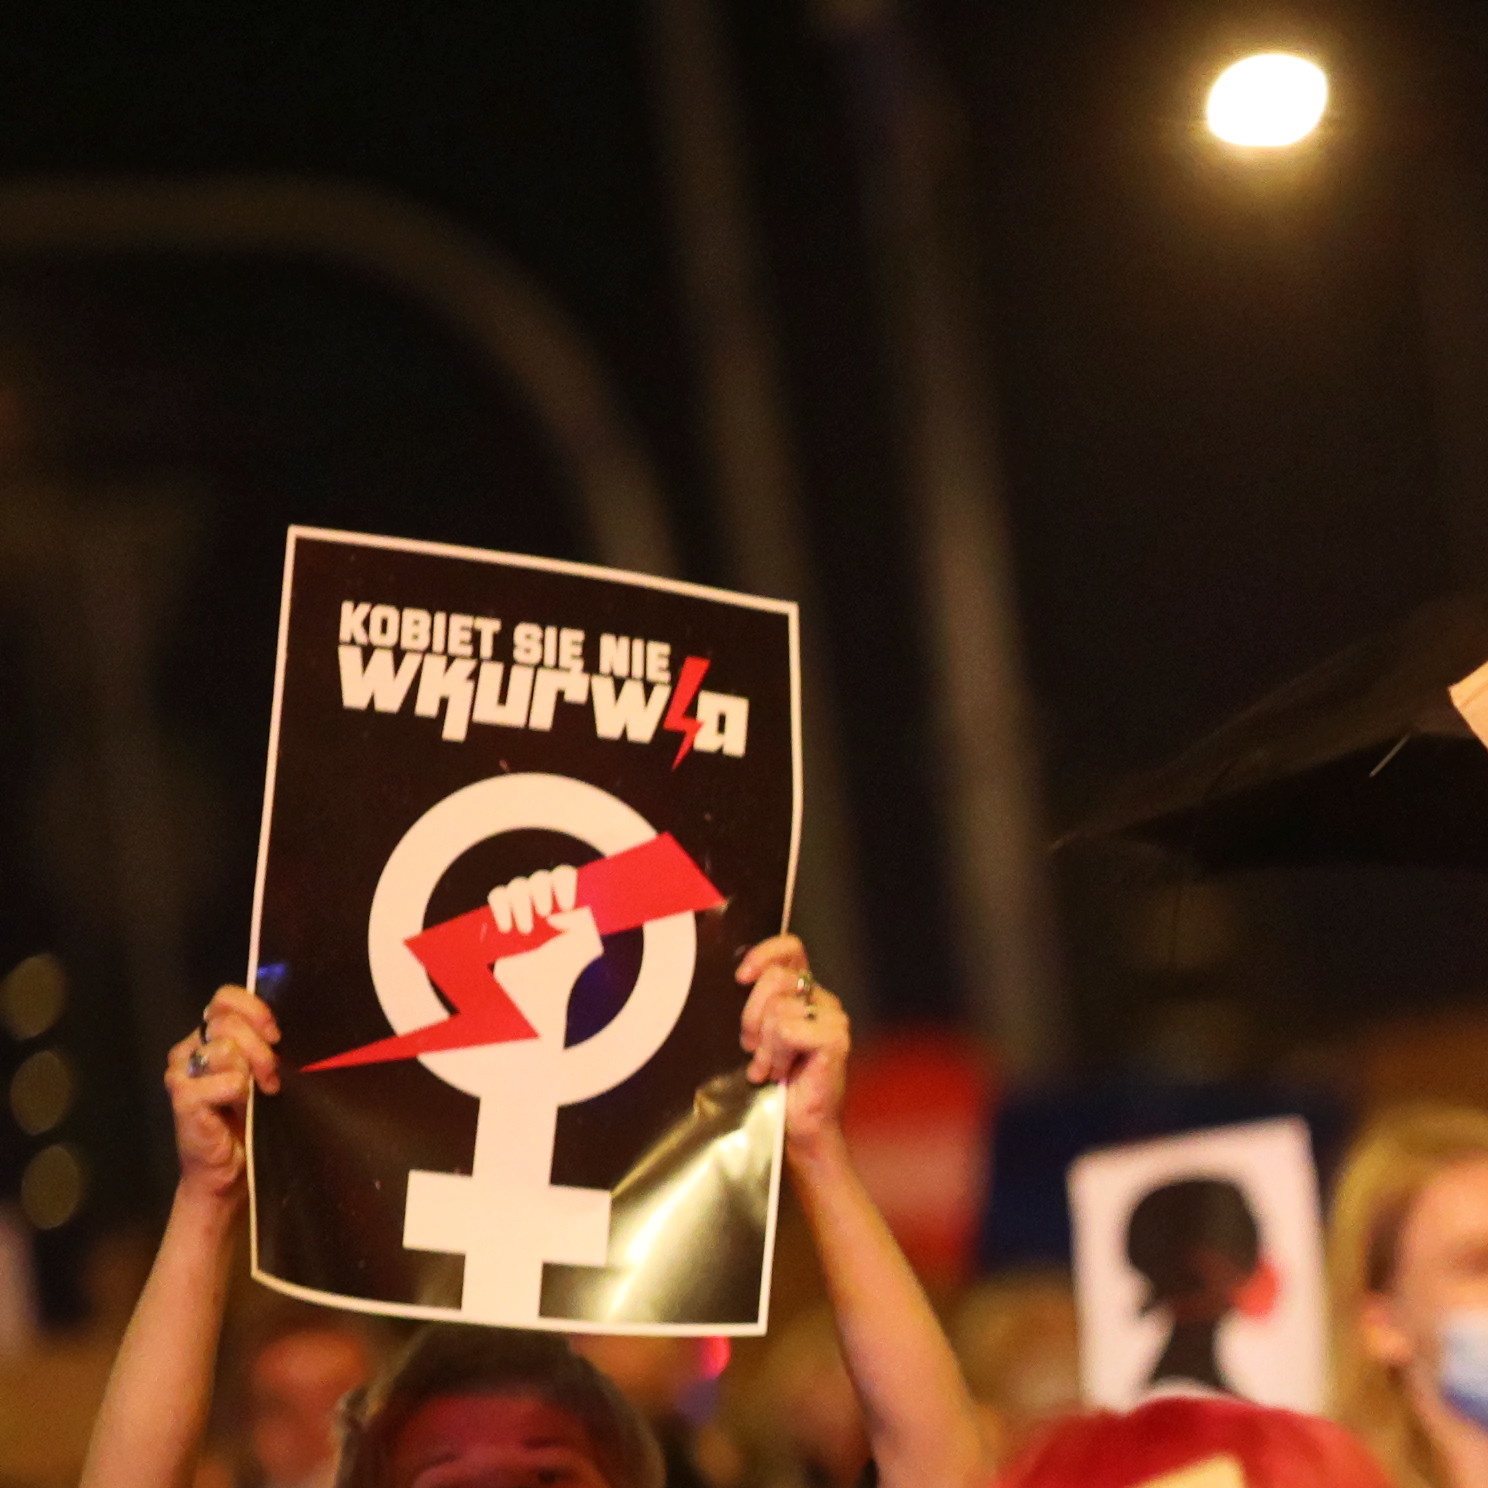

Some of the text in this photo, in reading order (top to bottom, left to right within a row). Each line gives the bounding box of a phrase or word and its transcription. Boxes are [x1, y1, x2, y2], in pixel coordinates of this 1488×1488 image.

[338, 600, 672, 684] KOBIET SIĘ NIE
